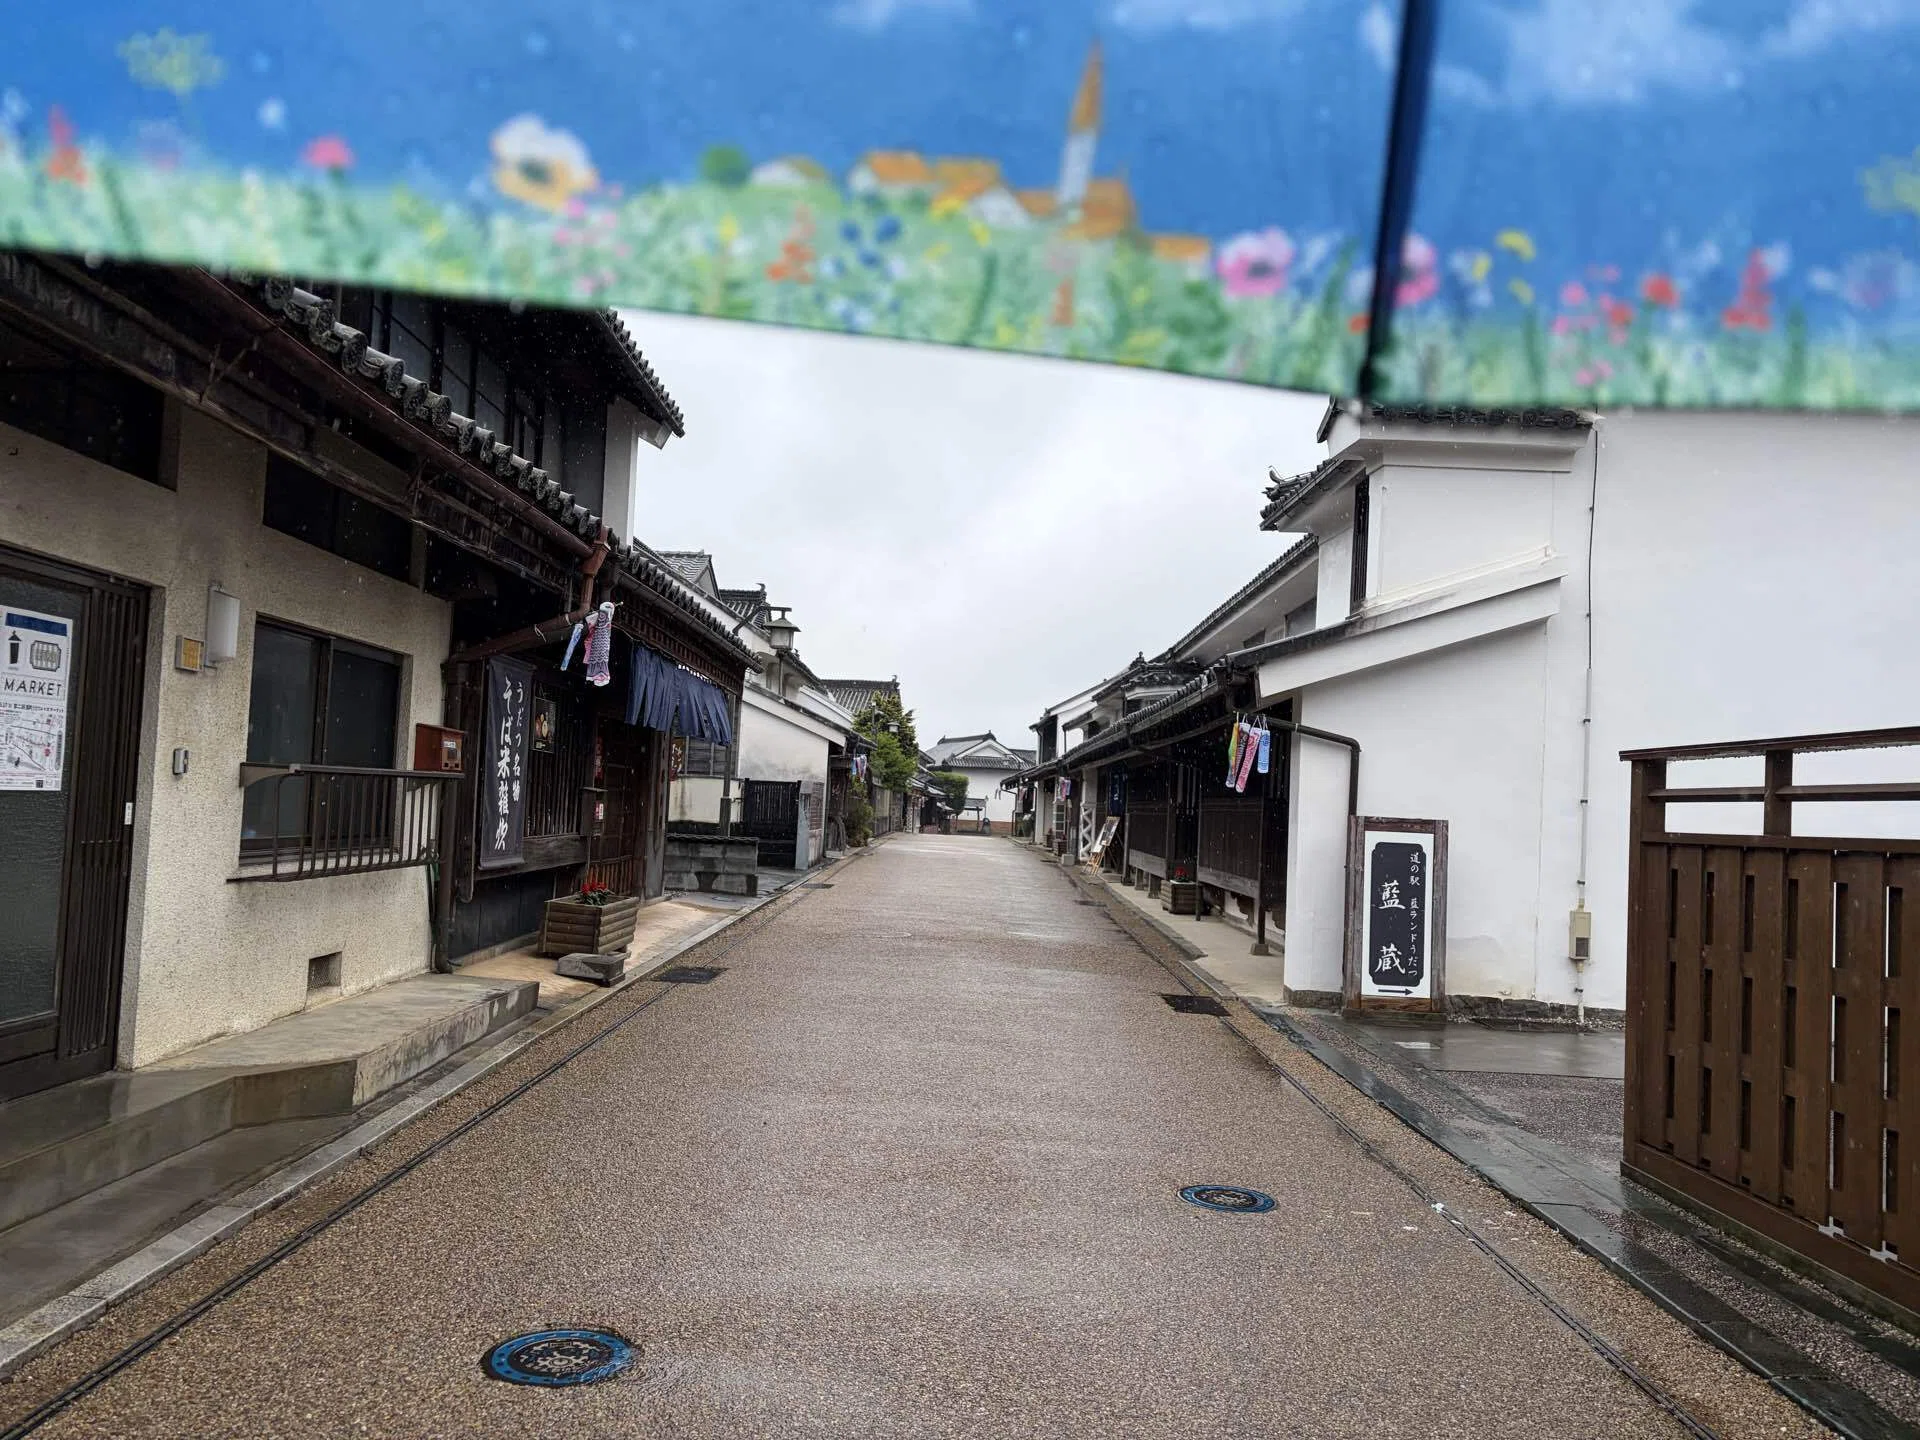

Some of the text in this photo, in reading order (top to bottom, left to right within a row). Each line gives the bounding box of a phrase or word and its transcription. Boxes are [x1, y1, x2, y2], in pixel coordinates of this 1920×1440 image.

[4, 677, 62, 697] MARKET
[513, 681, 524, 802] うだつ名物
[495, 677, 514, 851] そば米雑炊
[1374, 879, 1406, 975] 藍蔵
[1408, 852, 1421, 976] 道の駅 藍ランドうだつ
